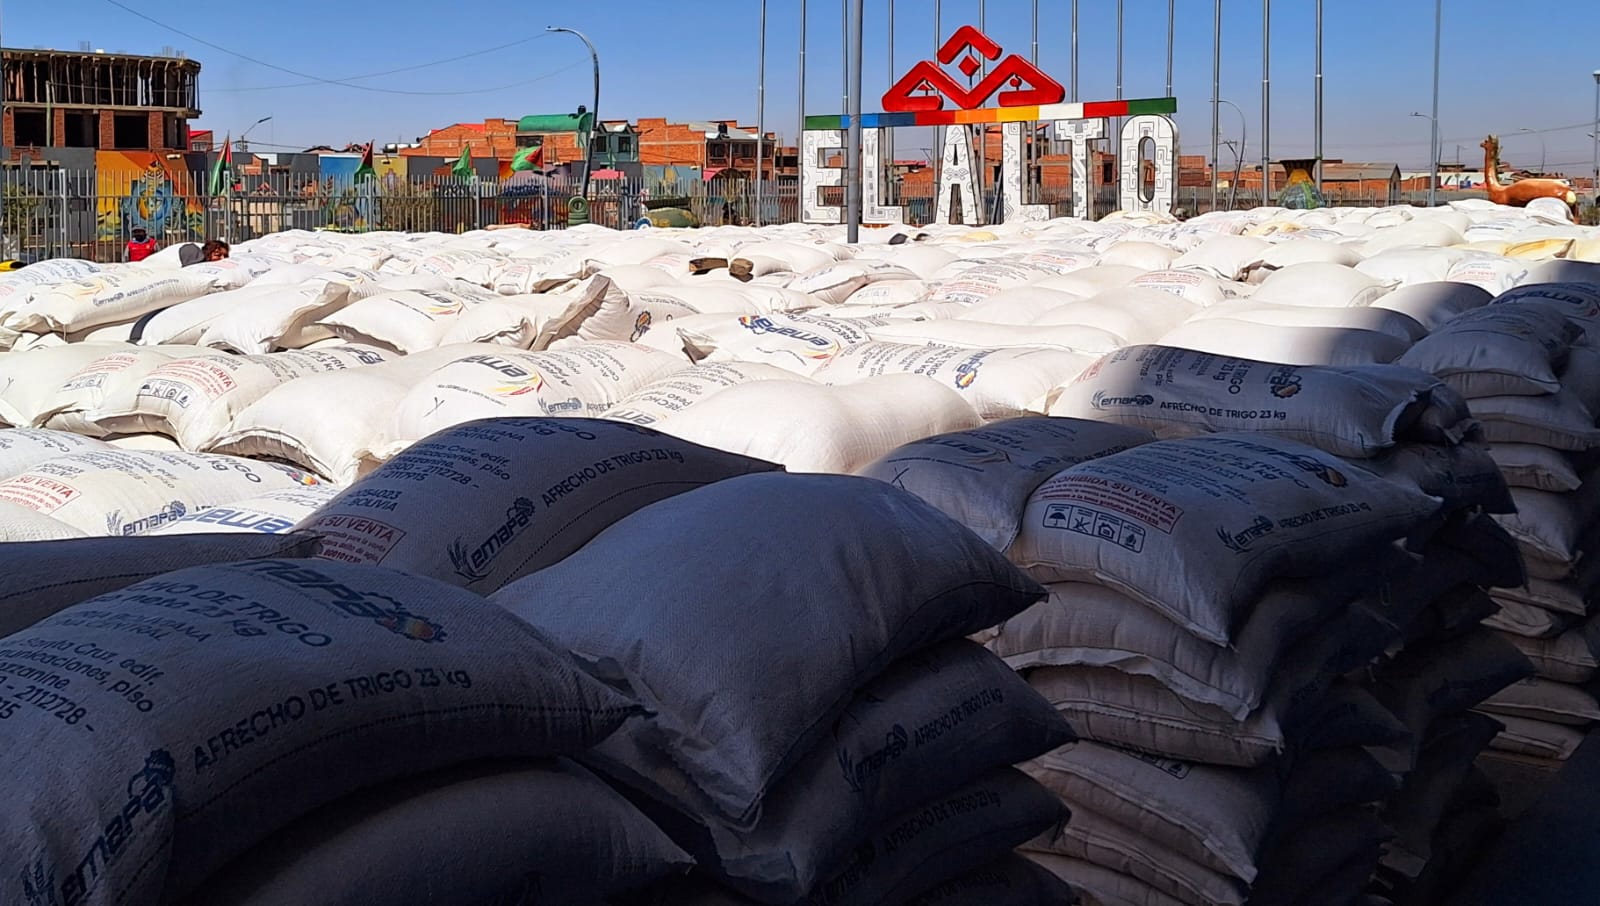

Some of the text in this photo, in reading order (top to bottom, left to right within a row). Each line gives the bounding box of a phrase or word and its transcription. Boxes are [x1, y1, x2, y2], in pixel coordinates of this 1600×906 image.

[803, 114, 1178, 226] EL ALTO
[1160, 401, 1206, 413] AFRECHO
[1209, 407, 1224, 417] DE
[1226, 410, 1258, 420] TRIGO
[1259, 410, 1272, 419] 23
[1274, 410, 1287, 421] kg
[34, 478, 74, 499] VENTA
[479, 462, 512, 481] piso
[541, 449, 685, 508] AFRECHO DE TRIGO 23 kg
[1110, 482, 1132, 493] SU
[1134, 488, 1176, 515] VENTA
[122, 509, 177, 537] emapa
[347, 519, 395, 543] VENTA
[470, 511, 531, 569] emapa
[237, 601, 332, 647] TRIGO
[74, 642, 119, 664] Cruz,
[119, 658, 165, 686] edif.
[14, 684, 87, 726] 2112728
[107, 680, 154, 713] piso
[194, 696, 306, 773] AFRECHO
[308, 683, 346, 712] DE
[344, 669, 412, 700] TRIGO
[413, 667, 441, 689] 23
[913, 714, 952, 749] AFRECHO
[951, 706, 963, 727] DE
[60, 782, 166, 906] emapa
